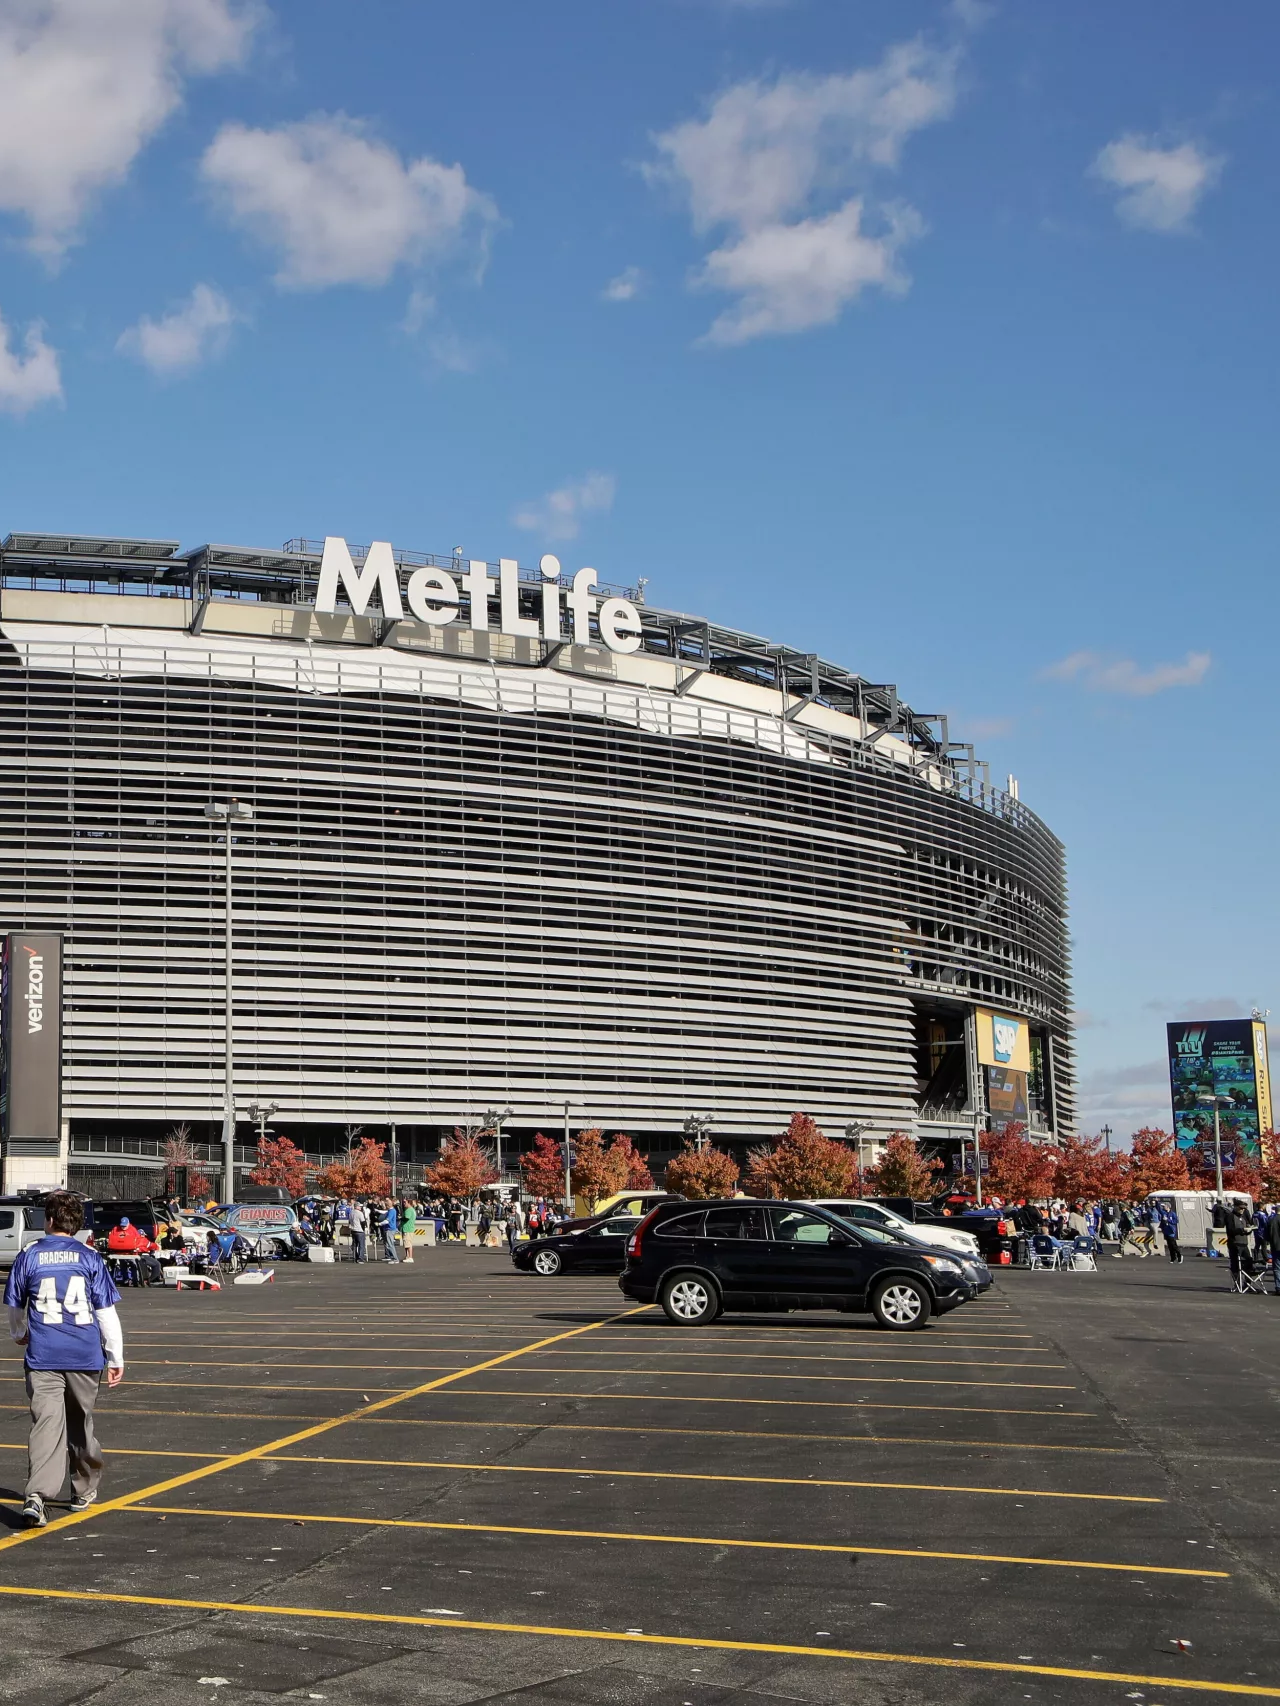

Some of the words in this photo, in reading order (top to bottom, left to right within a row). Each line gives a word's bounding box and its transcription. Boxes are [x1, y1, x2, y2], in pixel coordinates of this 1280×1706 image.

[314, 536, 642, 654] MetLife
[24, 956, 44, 1034] verizon
[994, 1023, 1017, 1056] SAP
[240, 1208, 287, 1220] GIANTS
[39, 1251, 80, 1265] BRADSHAW
[36, 1276, 93, 1325] 44
